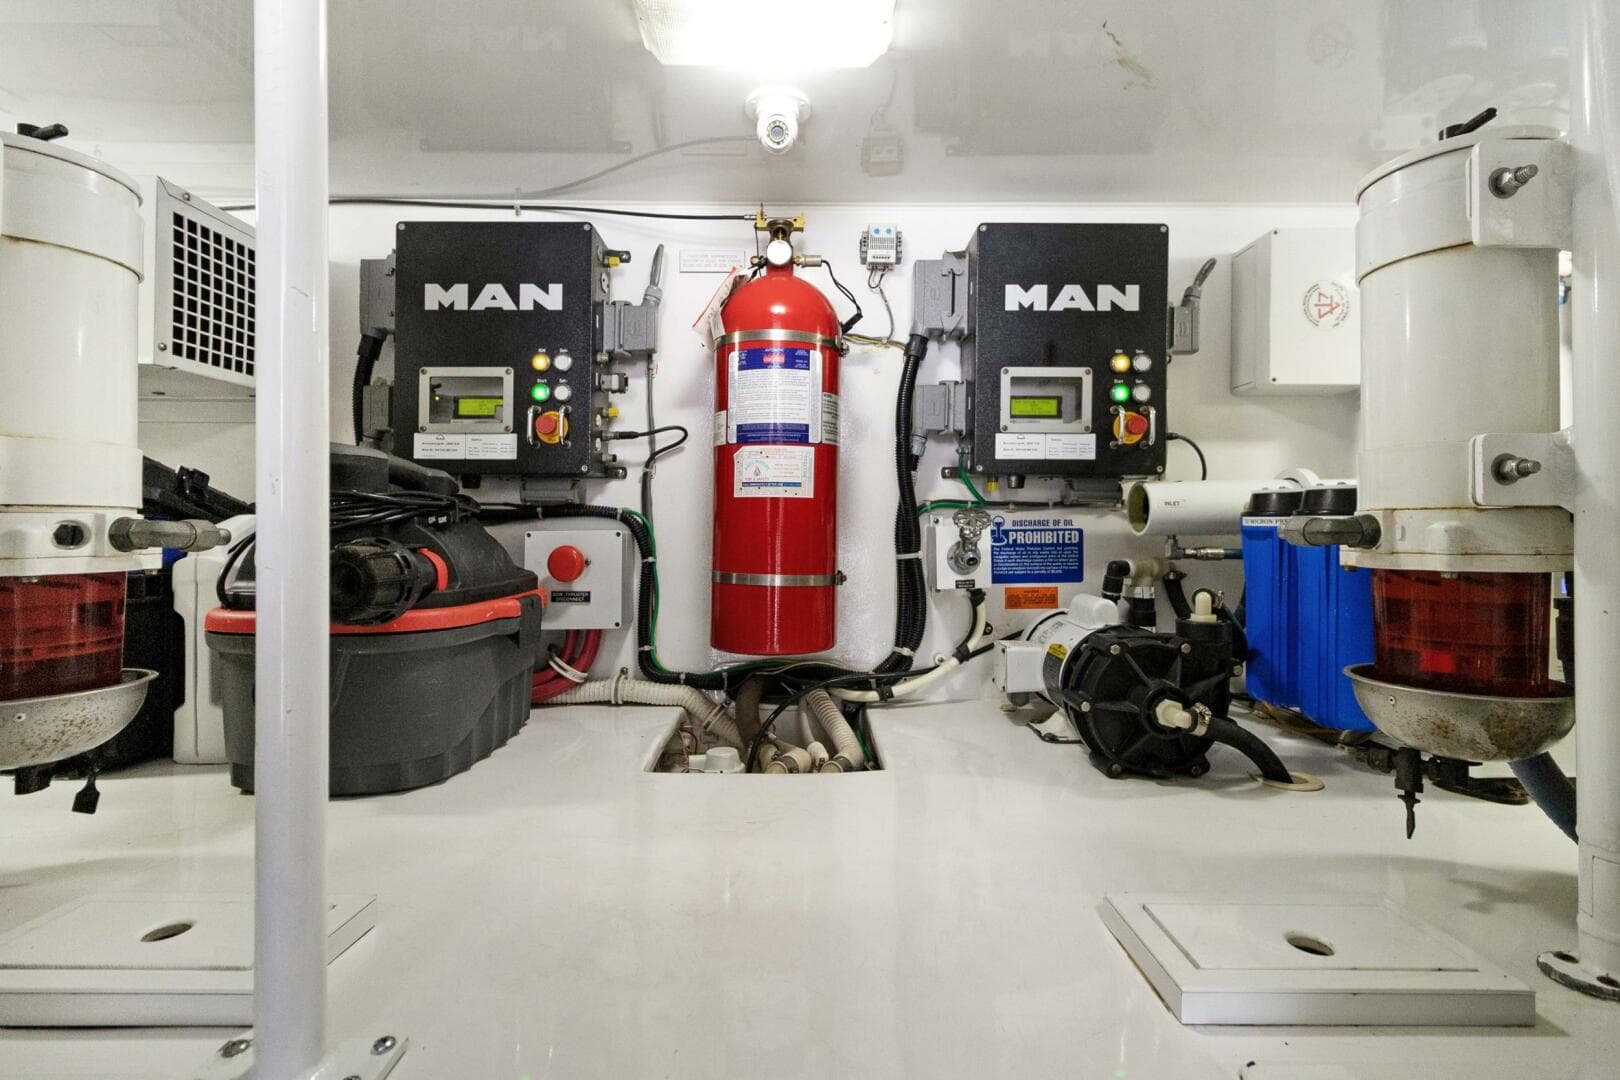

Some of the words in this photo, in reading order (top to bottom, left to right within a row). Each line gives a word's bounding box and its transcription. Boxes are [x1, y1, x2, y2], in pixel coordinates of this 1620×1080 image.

[424, 283, 563, 311] MAN
[1004, 284, 1140, 312] MAN
[1008, 531, 1079, 544] PROHIBITED
